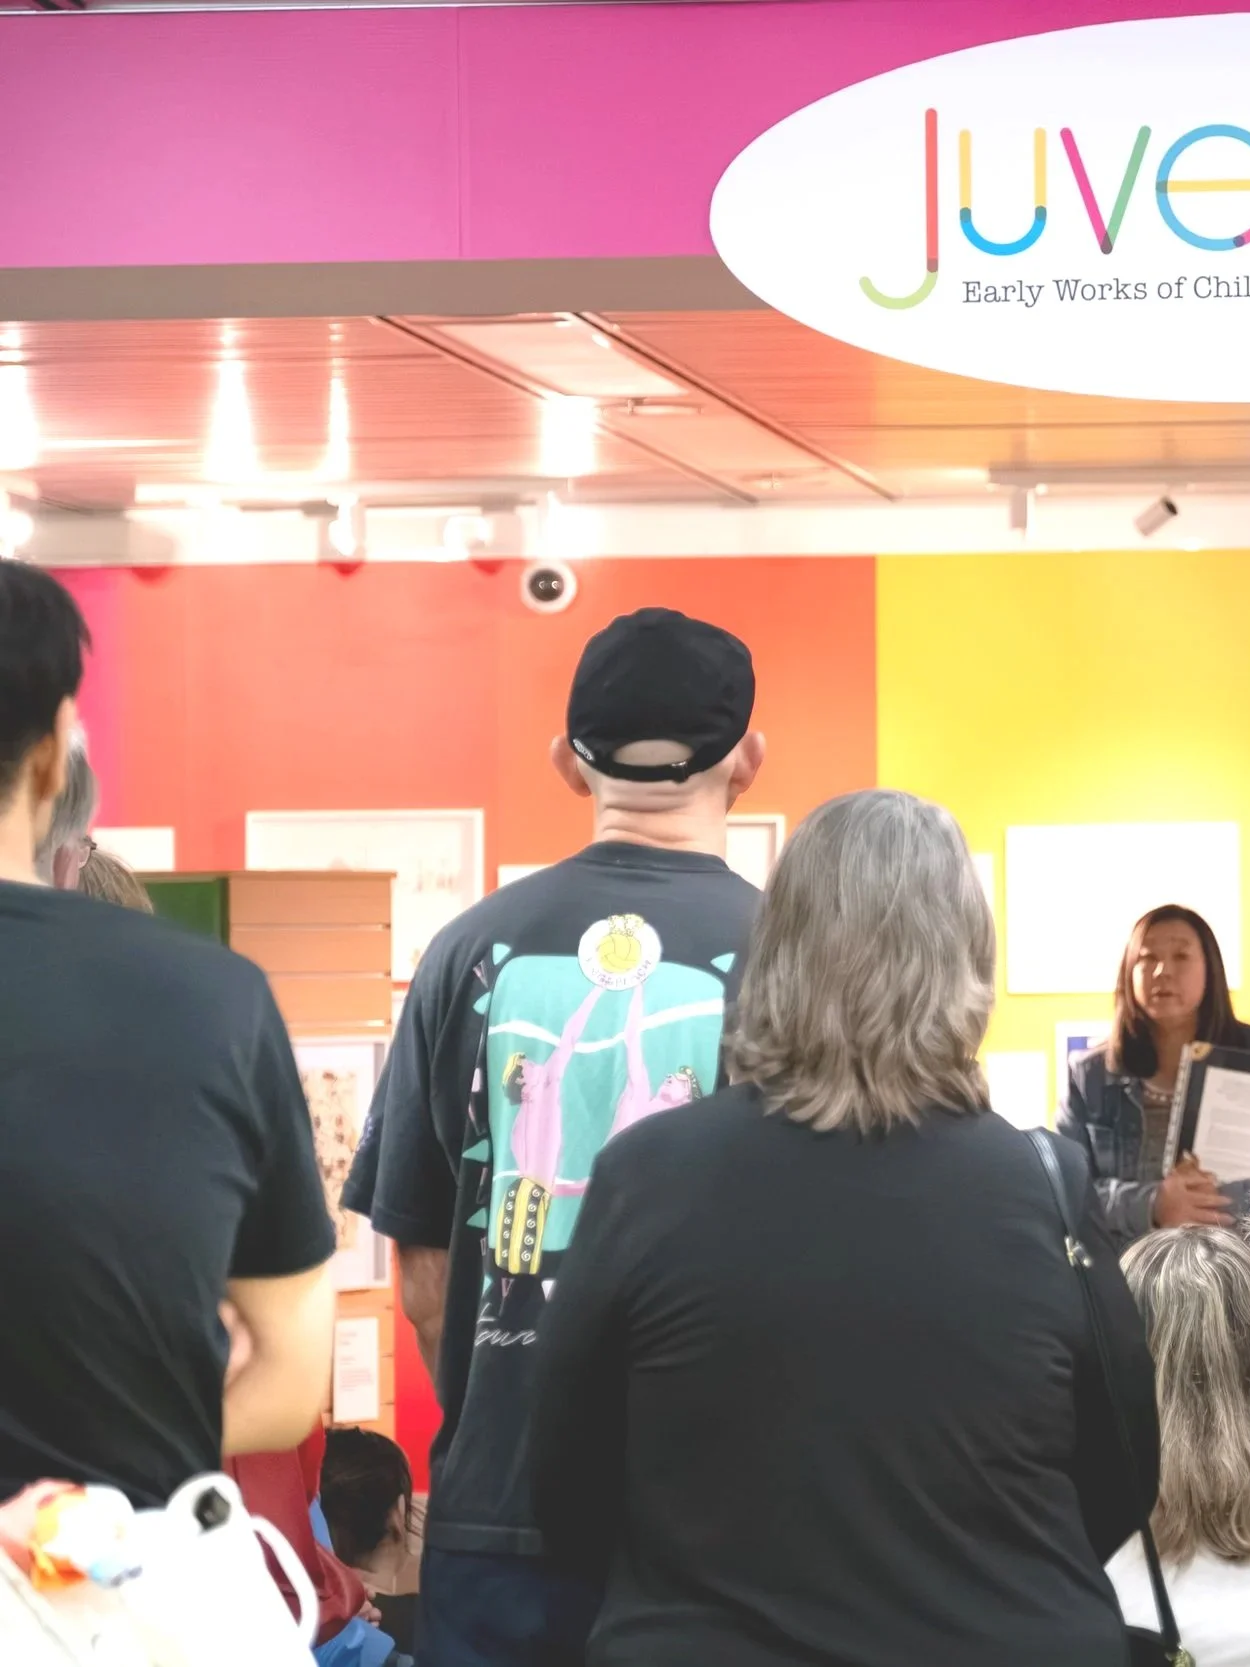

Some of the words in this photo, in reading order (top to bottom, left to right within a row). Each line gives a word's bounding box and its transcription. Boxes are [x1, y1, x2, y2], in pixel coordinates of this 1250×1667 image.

[961, 279, 1045, 308] Early
[1051, 277, 1148, 302] Works
[1156, 276, 1188, 300] of
